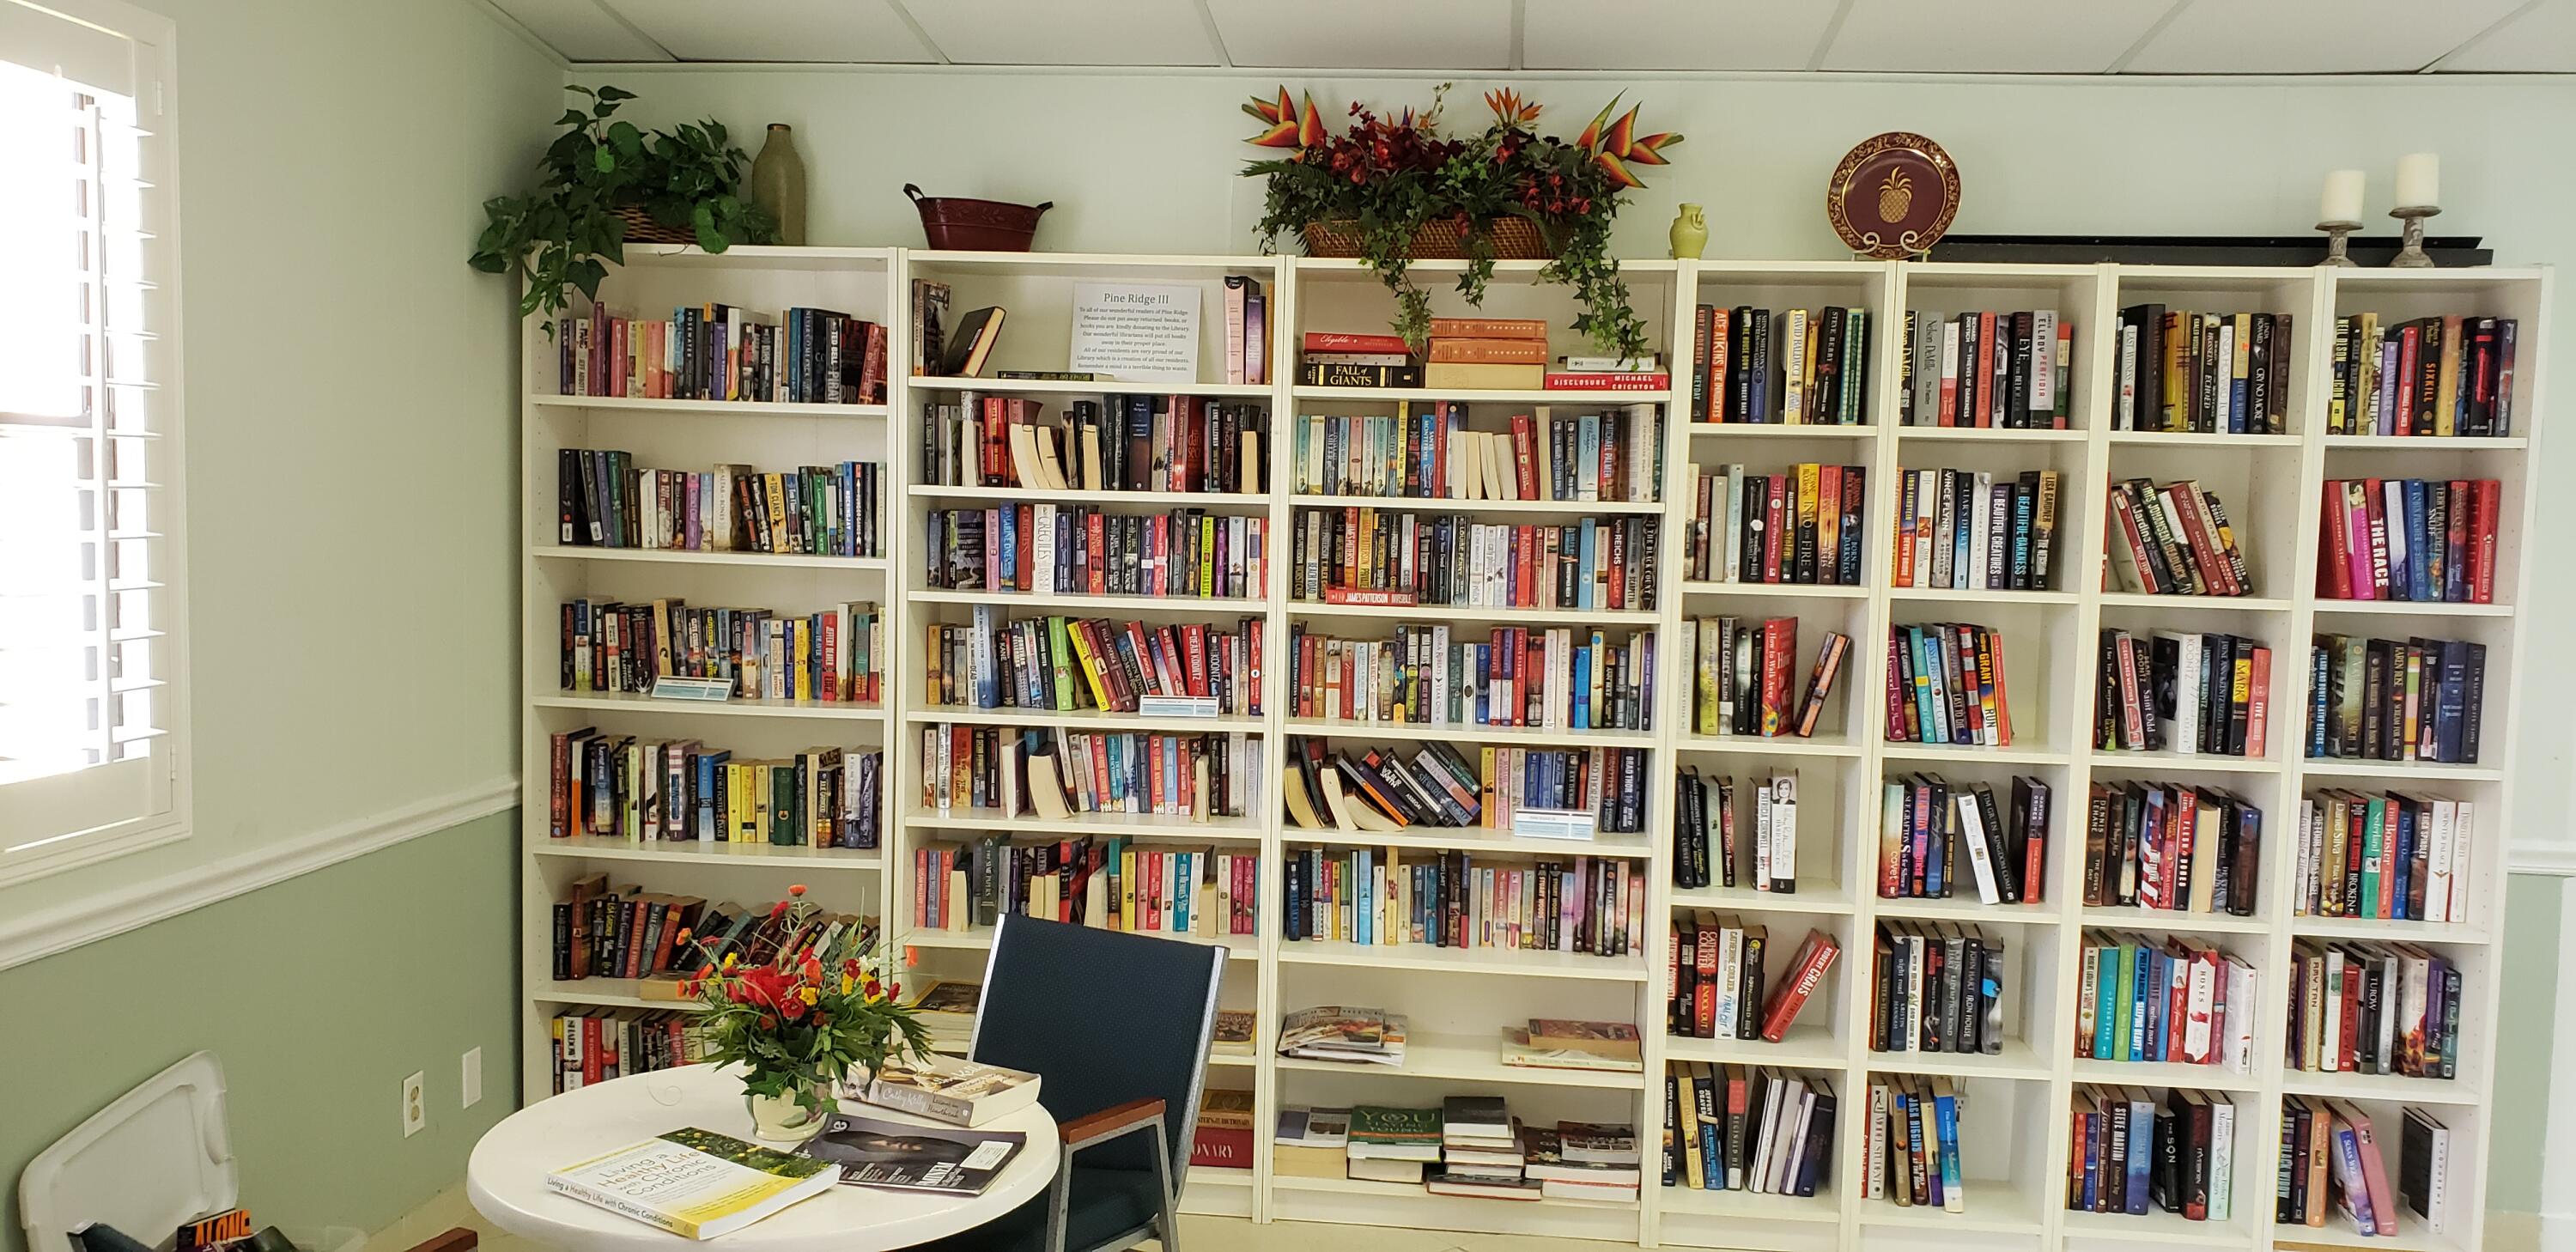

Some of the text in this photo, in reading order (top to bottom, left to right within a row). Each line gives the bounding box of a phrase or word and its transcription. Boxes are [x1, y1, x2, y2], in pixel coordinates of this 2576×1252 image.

[1104, 294, 1169, 305] Pine Ridge III
[1321, 335, 1349, 344] Eligible
[1716, 313, 1727, 331] ACE
[1693, 309, 1706, 400] KURT ANDERSEN HEYDAY
[1714, 332, 1726, 364] ATKINS
[2037, 319, 2047, 397] ELLROY PERFIDIA
[2334, 319, 2348, 397] NEIL OLSON ICON
[1330, 375, 1371, 386] GIANTS
[1336, 367, 1359, 375] FALL
[1714, 369, 1724, 380] THE
[2424, 363, 2435, 403] SIXKILL
[1963, 386, 1971, 417] DARKNESS
[2254, 368, 2264, 420] CRY NO MORE
[1604, 423, 1613, 477] MICHAEL PALMER
[2042, 477, 2056, 522] LISA GARDNER
[1037, 517, 1049, 559] GREG ILES
[1801, 501, 1814, 567] INTO FIRE
[1990, 499, 2006, 575] BEAUTIFUL CREATURES
[2014, 496, 2030, 574] BEAUTIFUL DARKNESS
[2142, 486, 2187, 580] IRIS JOHANSEN DEADLOCK
[1643, 530, 1654, 594] THE BLACK COUNT
[2372, 519, 2389, 586] THE RACE
[1189, 636, 1200, 680] DEAN KOONTZ
[1211, 654, 1219, 682] KOONTZ
[1767, 661, 1777, 680] Walk
[1769, 649, 1776, 659] to
[1765, 683, 1775, 701] Away
[1978, 653, 1996, 728] GRANT RUN
[2233, 663, 2248, 699] MARK
[2143, 690, 2155, 732] Saint Odd
[1625, 757, 1634, 774] BRAD
[1759, 792, 1769, 848] PATRICIA CORNWELL
[2091, 799, 2099, 832] LEHANE
[2098, 800, 2106, 833] DENNIS
[2332, 803, 2346, 854] Daniel Silva
[1890, 851, 1899, 880] covet
[2348, 873, 2358, 907] BROKEN
[1698, 931, 1710, 969] COULTER
[1707, 931, 1717, 969] CATHERINE
[1797, 946, 1833, 996] ROBERT CRAIS
[1700, 985, 1710, 1029] KNOCK OUT
[1963, 951, 1977, 1037] JOHN HART IRON HOUSE
[2368, 977, 2379, 1010] TUROW
[568, 1020, 576, 1056] SHADOW
[883, 1087, 927, 1112] Cathy Kelly
[1360, 1111, 1435, 1121] YOU
[1908, 1097, 1922, 1152] JACK HIGGINS
[2112, 1108, 2126, 1161] STEVE MARTINI
[599, 1159, 655, 1178] Living
[2166, 1137, 2177, 1163] SON
[598, 1164, 667, 1187] Healthy
[667, 1152, 700, 1164] Life
[627, 1164, 716, 1195] Conditions
[642, 1159, 707, 1182] Chronic
[548, 1178, 563, 1190] Living
[569, 1185, 592, 1200] Healthy
[592, 1194, 603, 1203] Life
[605, 1199, 617, 1208] with
[618, 1202, 640, 1216] Chronic
[641, 1211, 673, 1228] Conditions
[196, 1209, 250, 1246] ALONE
